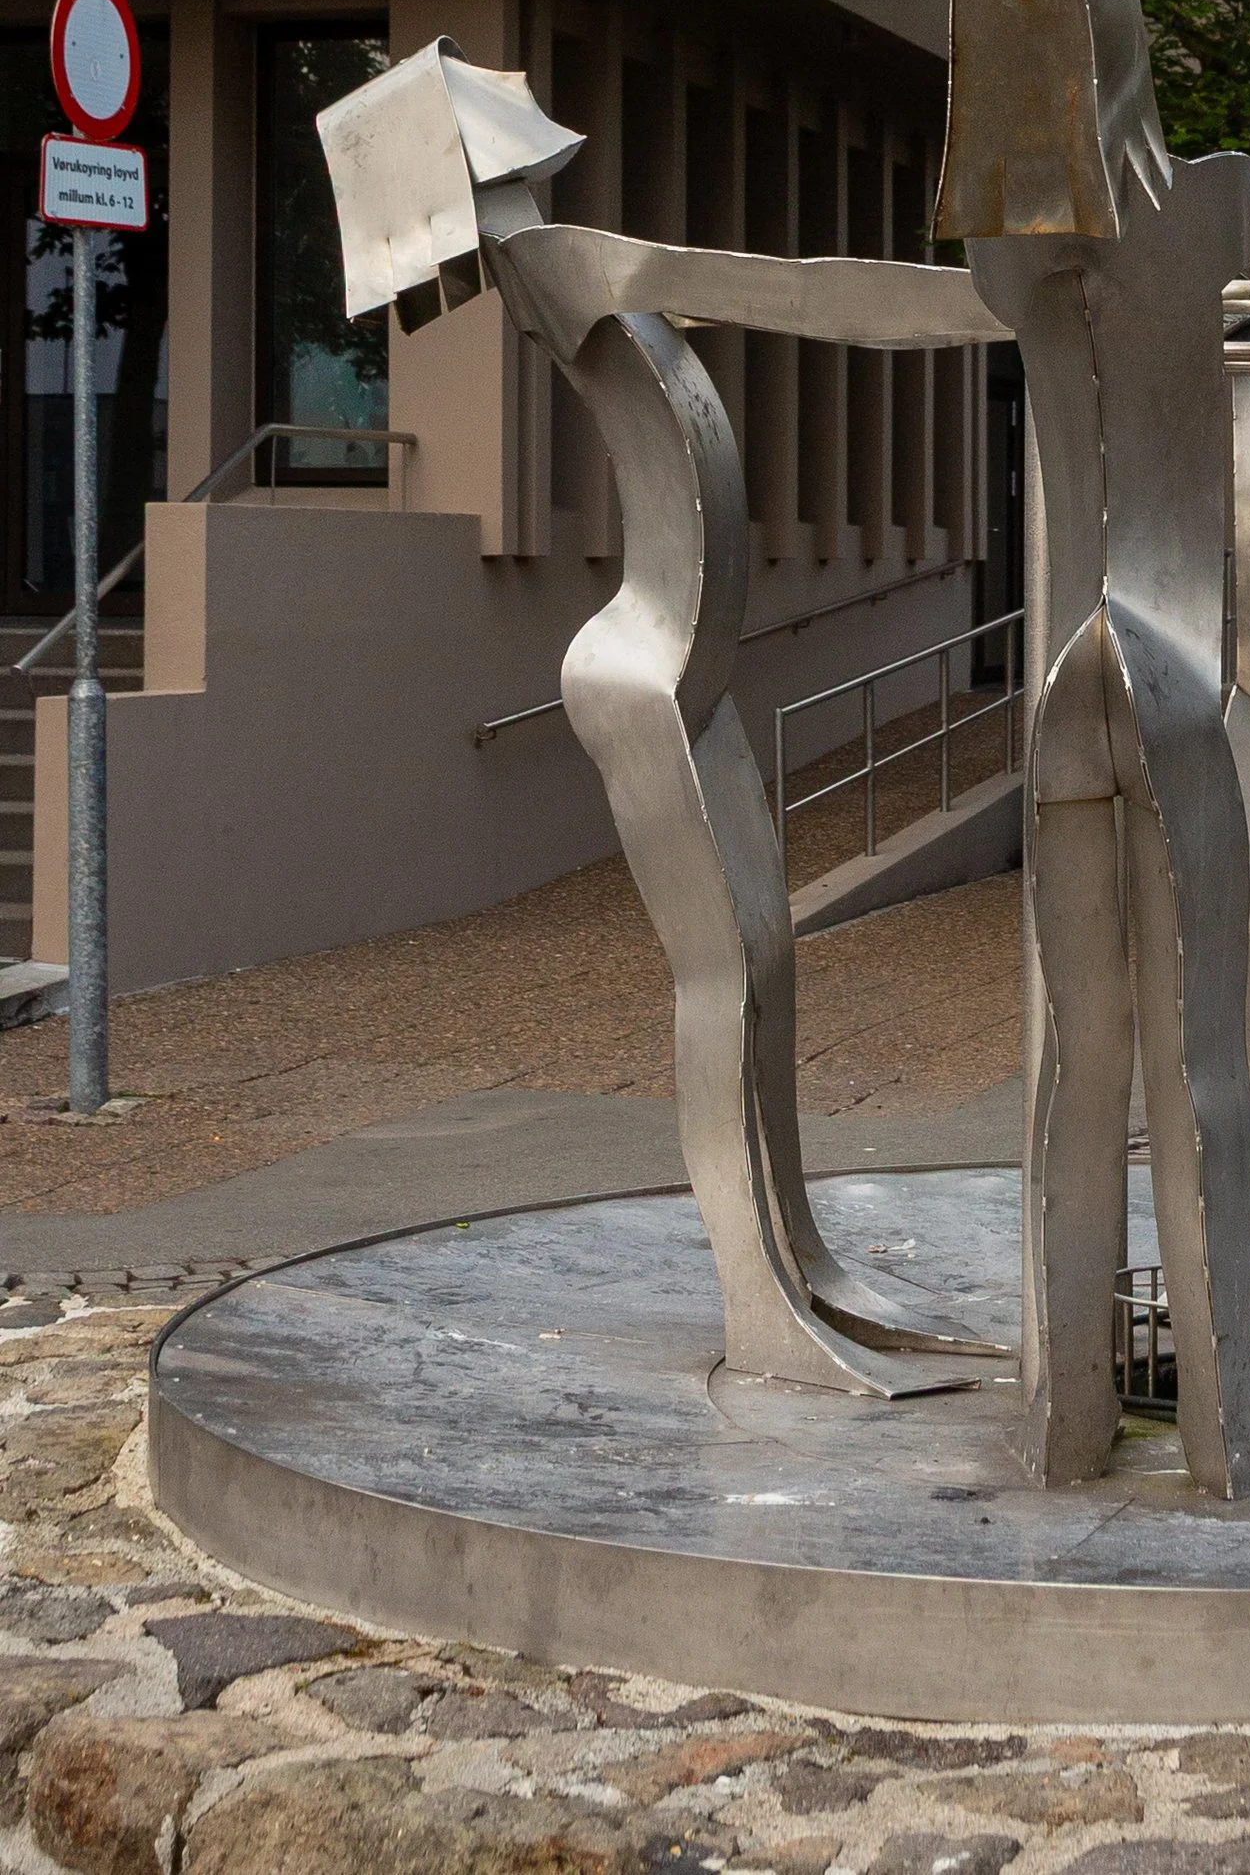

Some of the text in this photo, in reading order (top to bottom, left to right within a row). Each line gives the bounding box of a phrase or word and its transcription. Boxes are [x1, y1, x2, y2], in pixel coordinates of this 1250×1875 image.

[58, 189, 94, 204] millum
[95, 192, 108, 207] kl.
[109, 194, 116, 207] 6
[122, 196, 134, 210] 12
